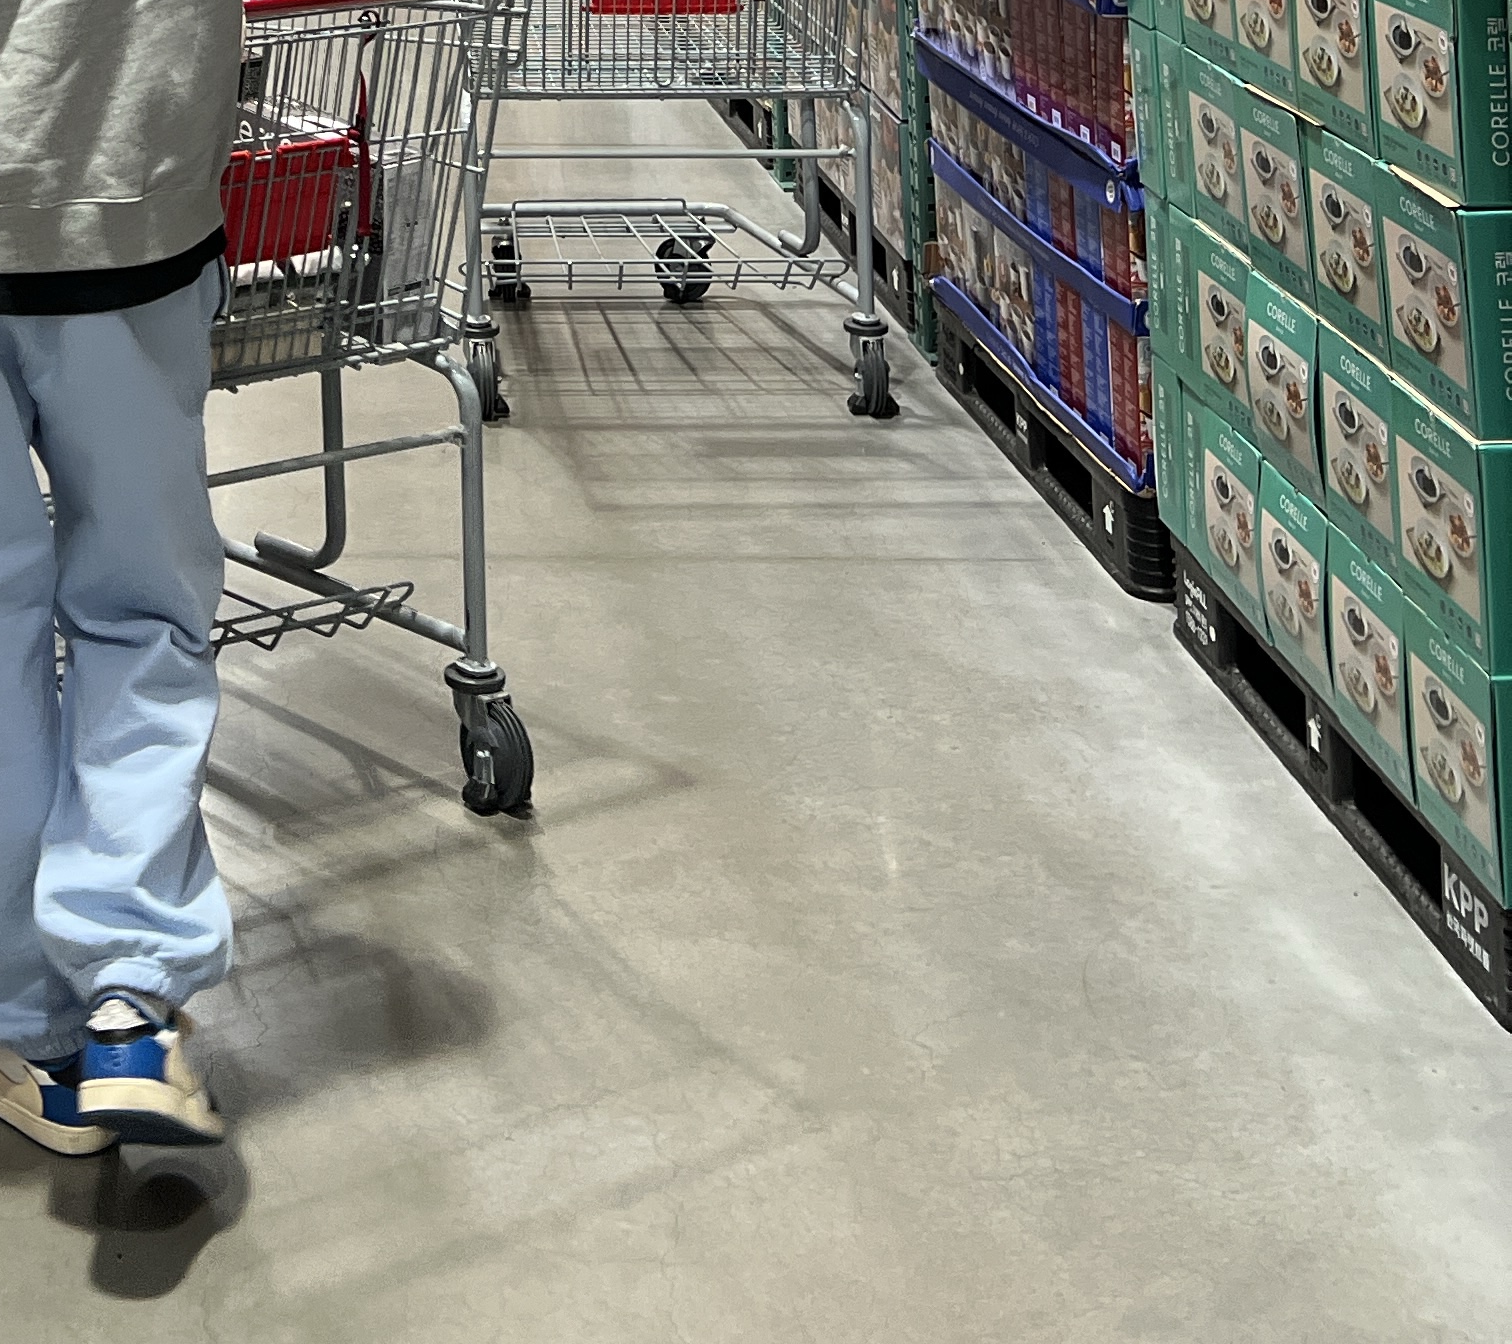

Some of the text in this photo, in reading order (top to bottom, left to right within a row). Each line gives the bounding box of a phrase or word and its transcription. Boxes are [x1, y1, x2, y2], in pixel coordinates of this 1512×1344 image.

[1486, 16, 1511, 168] CORELLE 코렐
[1323, 147, 1354, 178] CORELLE
[1399, 196, 1435, 230] CORELLE
[1266, 301, 1297, 333] CORELLE
[1339, 354, 1373, 392] CORELLE
[1414, 418, 1451, 458] CORELLE
[1279, 494, 1310, 532] CORELLE
[1350, 560, 1384, 603] CORELLE
[1428, 637, 1466, 686] CORELLE
[1443, 861, 1489, 935] KPP
